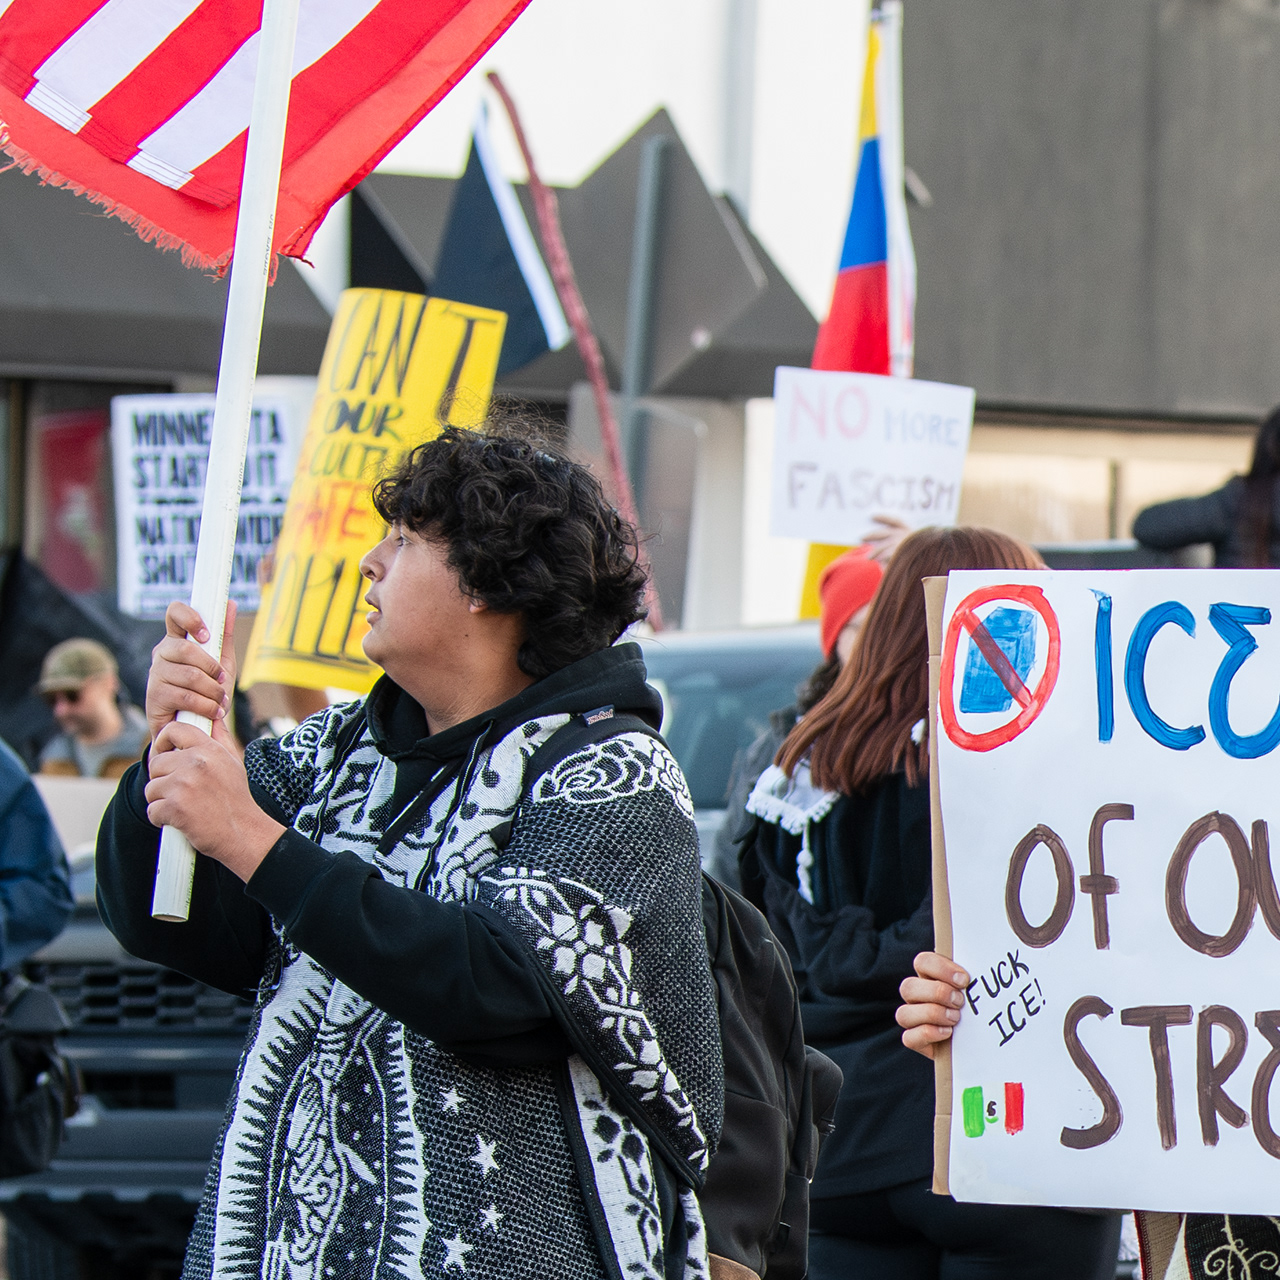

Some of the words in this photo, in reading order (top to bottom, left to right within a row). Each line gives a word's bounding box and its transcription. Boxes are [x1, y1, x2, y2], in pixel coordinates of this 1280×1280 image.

[131, 409, 283, 446] MINNETA
[323, 399, 404, 442] OUR
[789, 382, 871, 444] NO
[883, 407, 961, 448] MORE
[787, 460, 957, 512] FASCISM
[965, 948, 1030, 1016] FUCK
[988, 977, 1047, 1048] ICE!
